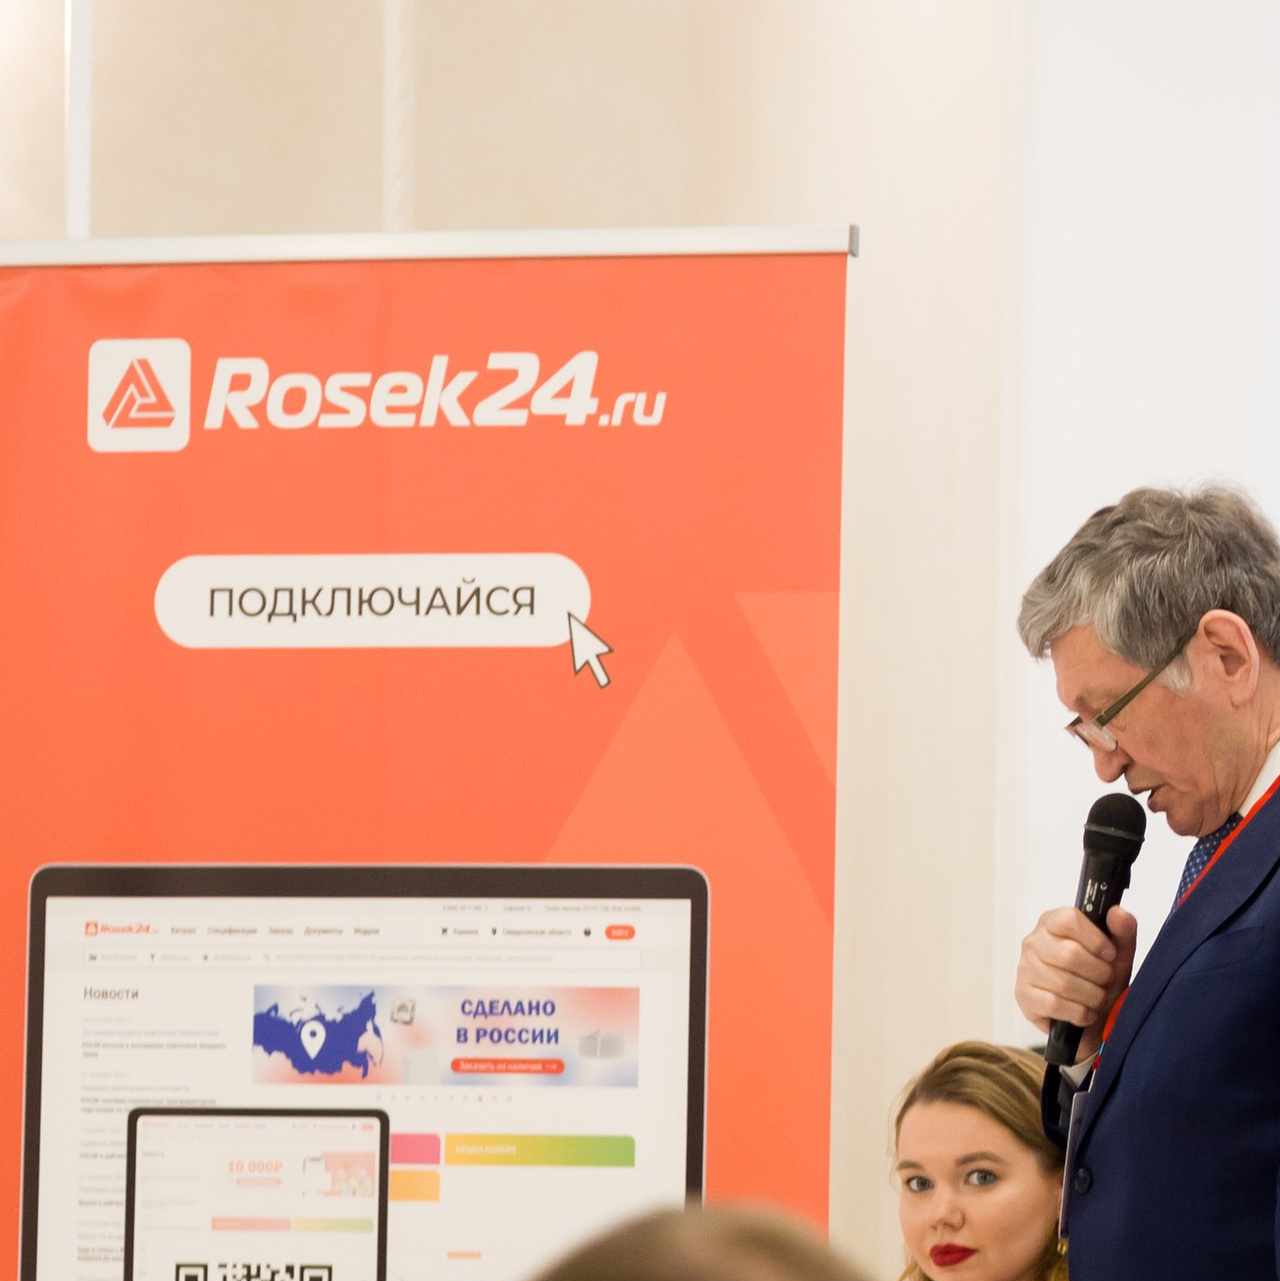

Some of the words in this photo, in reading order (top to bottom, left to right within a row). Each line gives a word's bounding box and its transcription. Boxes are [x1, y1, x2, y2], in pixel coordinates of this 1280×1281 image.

[204, 350, 667, 429] Rosek24.ru
[207, 576, 537, 624] ПОДКЛЮЧАЙСЯ
[82, 986, 139, 1000] Новости
[460, 999, 556, 1019] СДЕЛАНО
[456, 1027, 469, 1045] В
[475, 1027, 559, 1046] РОССИИ
